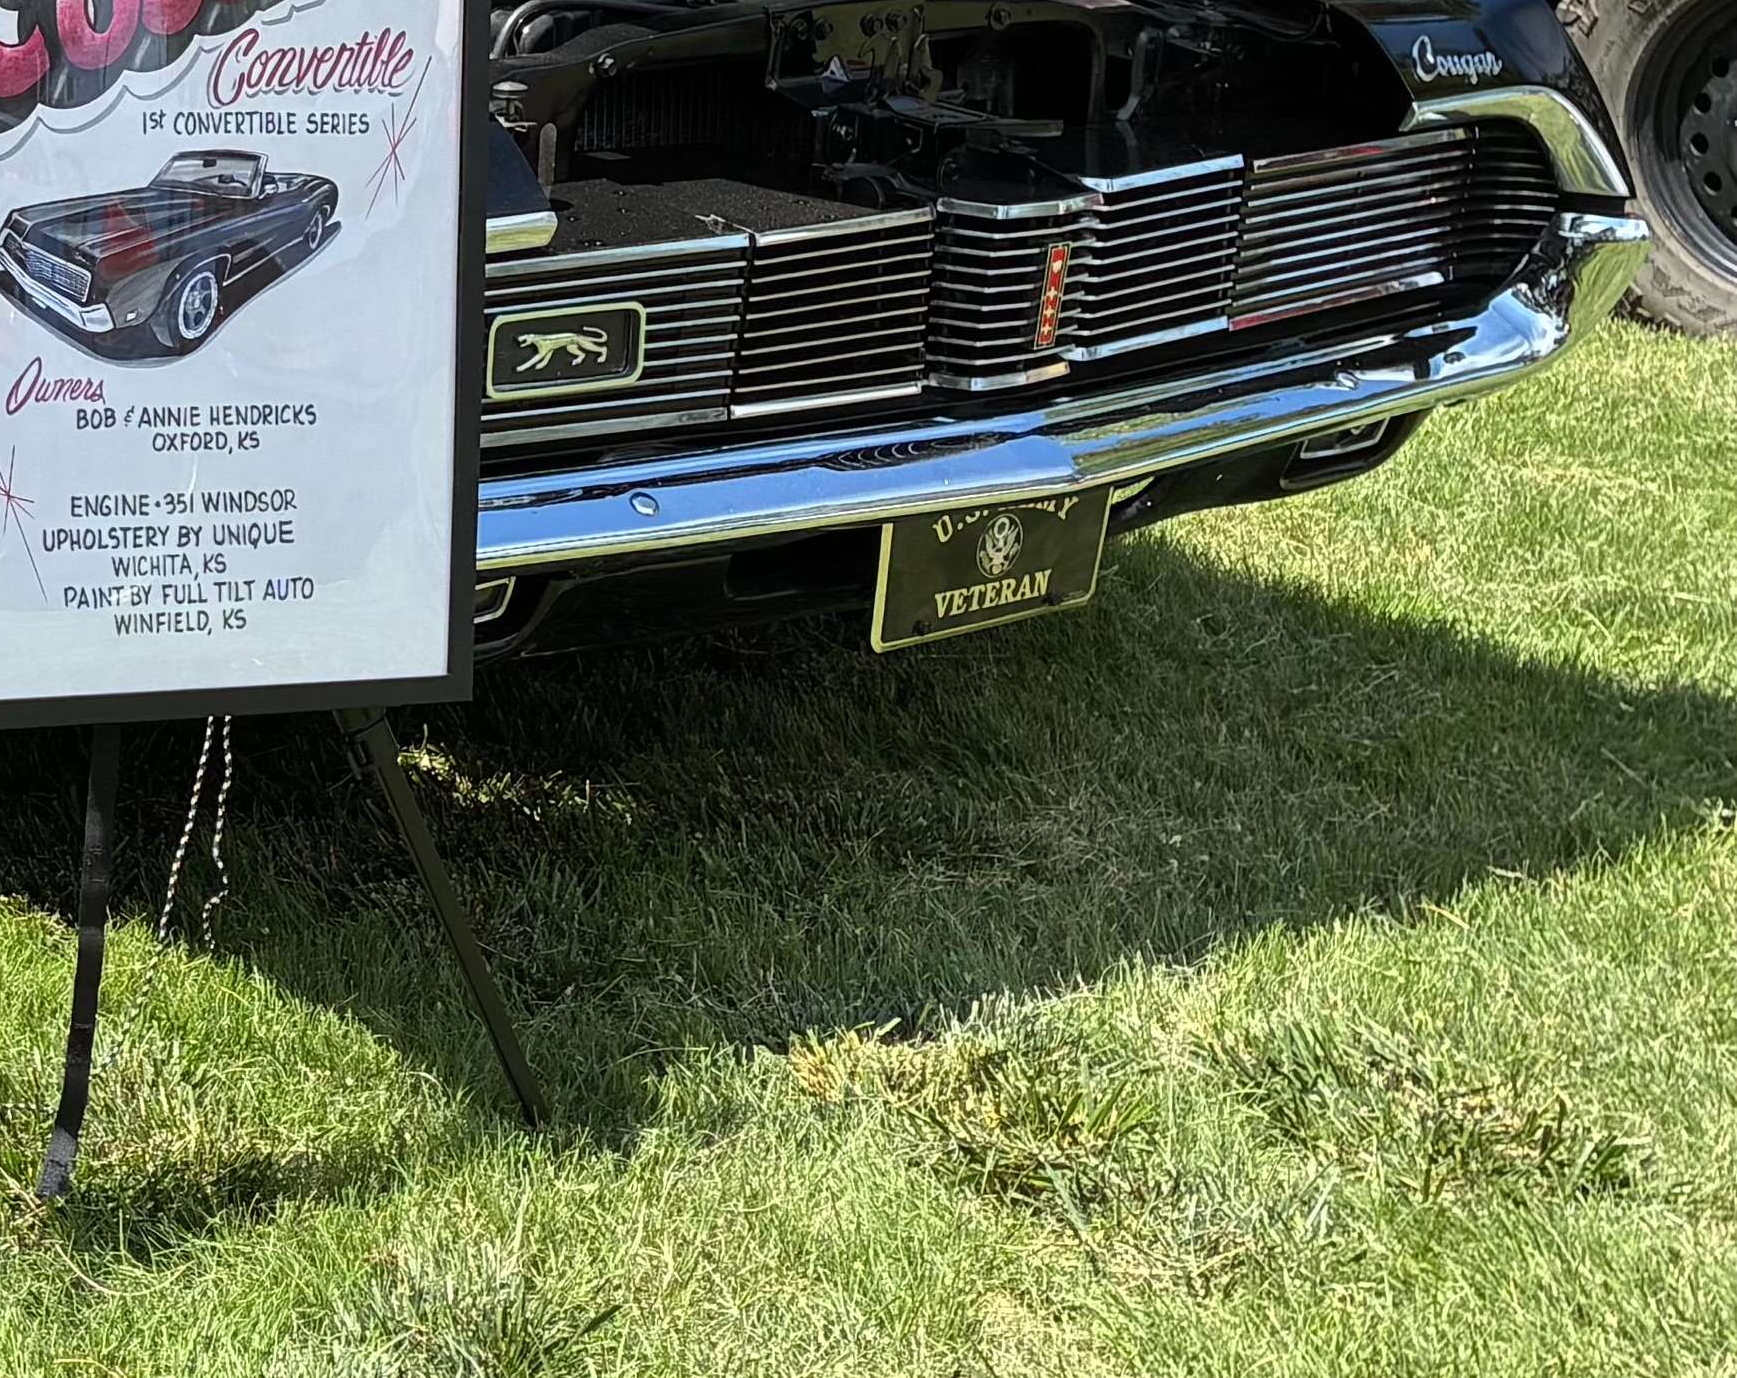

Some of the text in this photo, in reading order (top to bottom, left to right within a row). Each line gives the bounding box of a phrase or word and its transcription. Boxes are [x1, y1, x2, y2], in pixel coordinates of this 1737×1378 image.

[210, 27, 415, 107] Convertible
[1412, 35, 1503, 85] Cougar
[174, 110, 297, 135] CONVERTIBLE
[306, 112, 370, 135] SERIES
[5, 356, 105, 416] Owners
[77, 404, 317, 430] BOB & ANNIE HENDRICKS
[153, 431, 259, 454] OXFORD, KS
[201, 488, 298, 513] WINDSOR
[42, 520, 295, 552] UPHOLSTERY BY UNIQUE
[111, 552, 227, 581] WICHITA, KS
[64, 577, 314, 610] PAINT BY FULL TILT AUTO
[934, 568, 1053, 619] VETERAN
[114, 608, 247, 636] WINFIELD, KS
